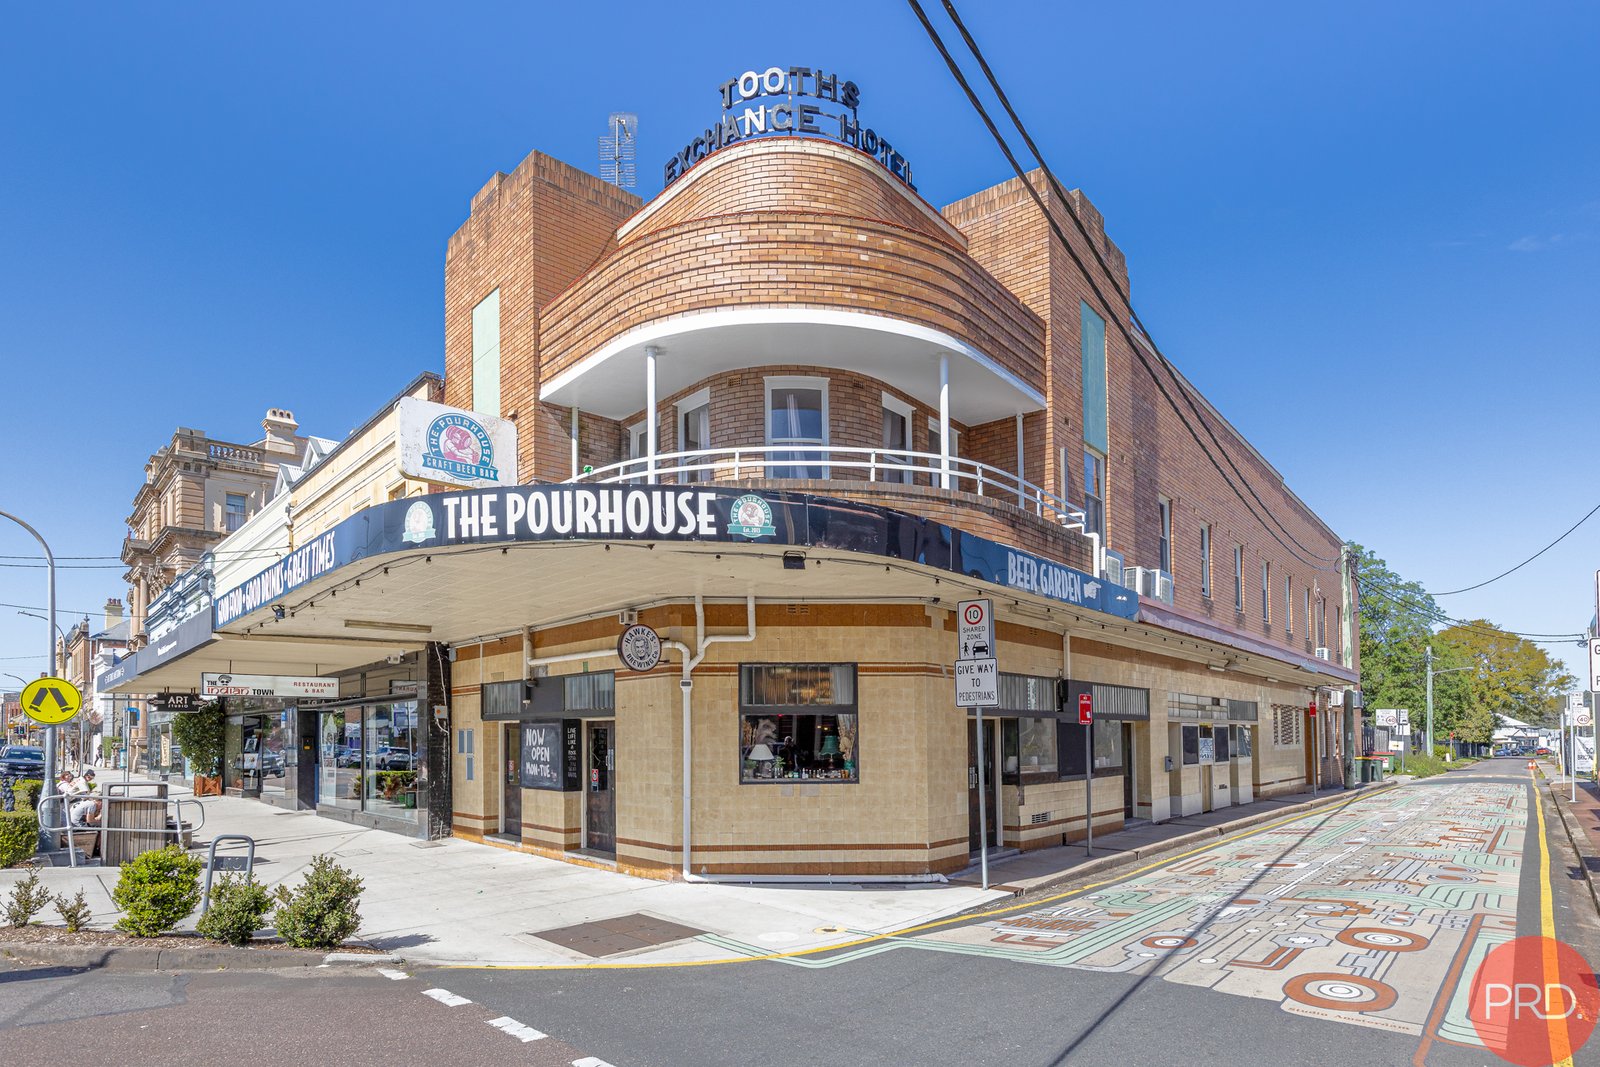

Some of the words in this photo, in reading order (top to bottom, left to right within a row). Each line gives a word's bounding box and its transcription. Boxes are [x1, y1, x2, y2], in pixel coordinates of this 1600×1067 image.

[718, 66, 860, 109] TOOTHS
[664, 104, 820, 188] EXCHANGE
[840, 113, 917, 193] HOTEL
[429, 430, 439, 453] THE
[439, 416, 490, 463] POURHOUSE
[427, 457, 452, 471] CRAFT
[456, 461, 477, 476] BEER
[480, 468, 495, 479] BAR
[442, 493, 498, 539] THE
[506, 489, 718, 535] POURHOUSE
[261, 562, 284, 604] DRINKS
[287, 547, 311, 589] GREAT
[311, 530, 335, 577] TIMES
[1007, 551, 1038, 592] BEER
[1040, 563, 1082, 603] GARDEN
[969, 609, 979, 620] 10
[625, 627, 656, 645] HAWKE'S
[962, 625, 986, 634] SHARED
[966, 633, 982, 641] ZONE
[626, 653, 655, 668] BREWING
[957, 665, 974, 675] GIVE
[977, 664, 994, 674] WAY
[971, 678, 981, 687] TO
[168, 696, 189, 705] ART
[958, 690, 995, 702] PEDESTRIANS
[525, 728, 545, 747] NOW
[531, 747, 550, 762] OPEN
[525, 761, 551, 778] MON-TUE
